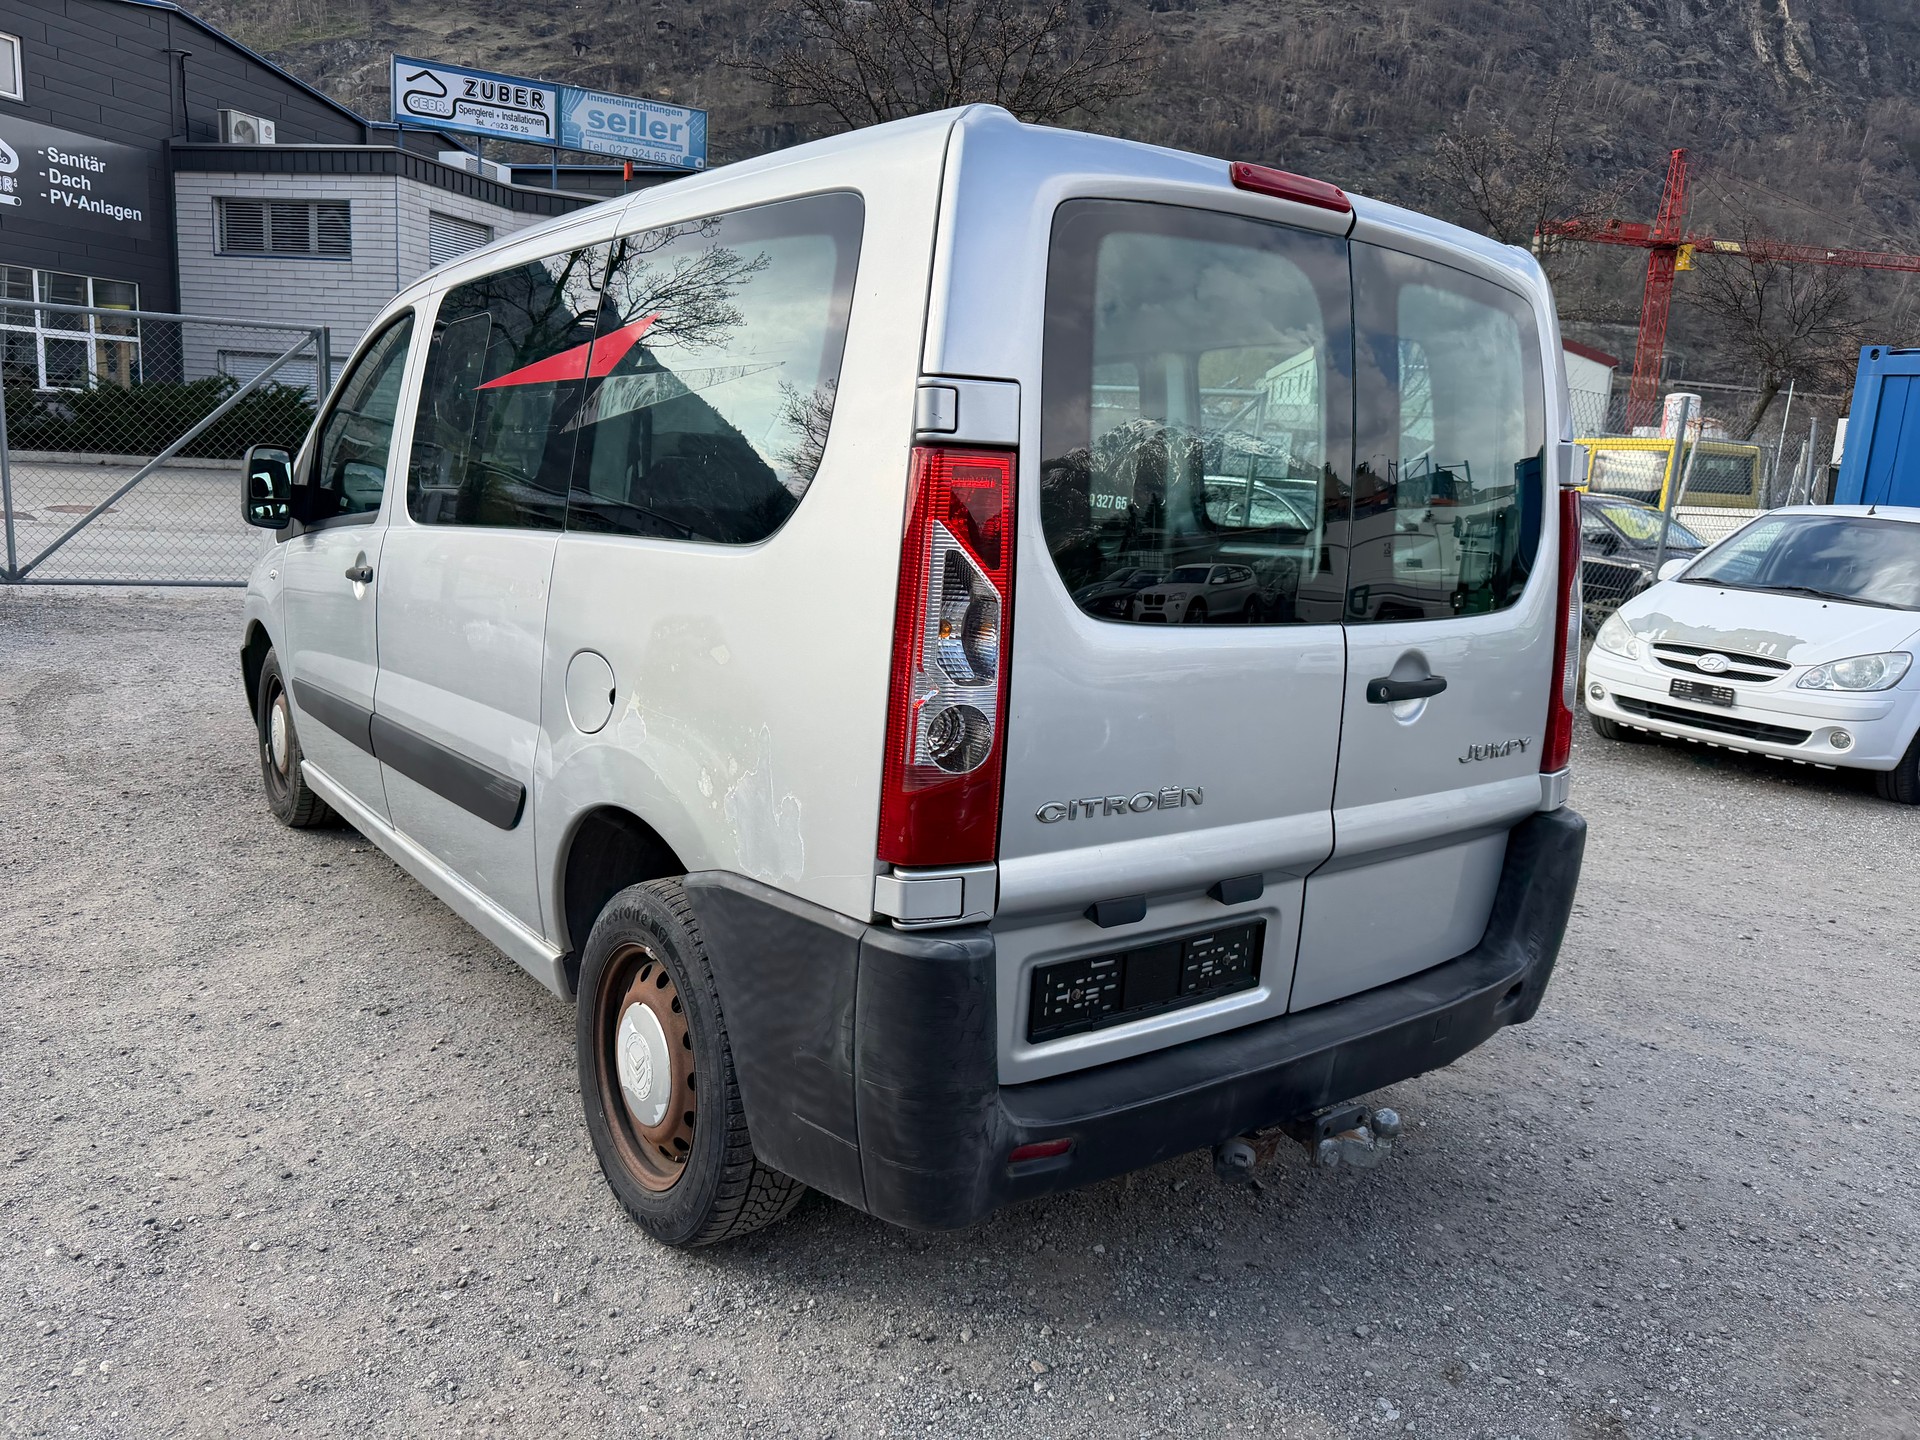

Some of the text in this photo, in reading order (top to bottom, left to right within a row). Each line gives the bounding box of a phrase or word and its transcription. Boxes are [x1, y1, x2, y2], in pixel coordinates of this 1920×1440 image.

[409, 96, 449, 114] GEBR.
[463, 78, 545, 110] ZUBER
[587, 92, 683, 117] Inneneinrichtungen
[458, 104, 545, 126] Spenglerei Installationen
[587, 109, 683, 142] seiler
[47, 147, 106, 173] Sanitär
[609, 144, 628, 156] 027
[632, 147, 650, 160] 924
[654, 151, 667, 162] 65
[669, 153, 682, 164] 60
[49, 168, 91, 191] Dach
[50, 189, 142, 221] PV-Anlagen
[1096, 494, 1114, 509] 327
[1115, 495, 1127, 510] 65
[1458, 736, 1531, 764] JUMPY
[1035, 785, 1204, 824] CITROËN
